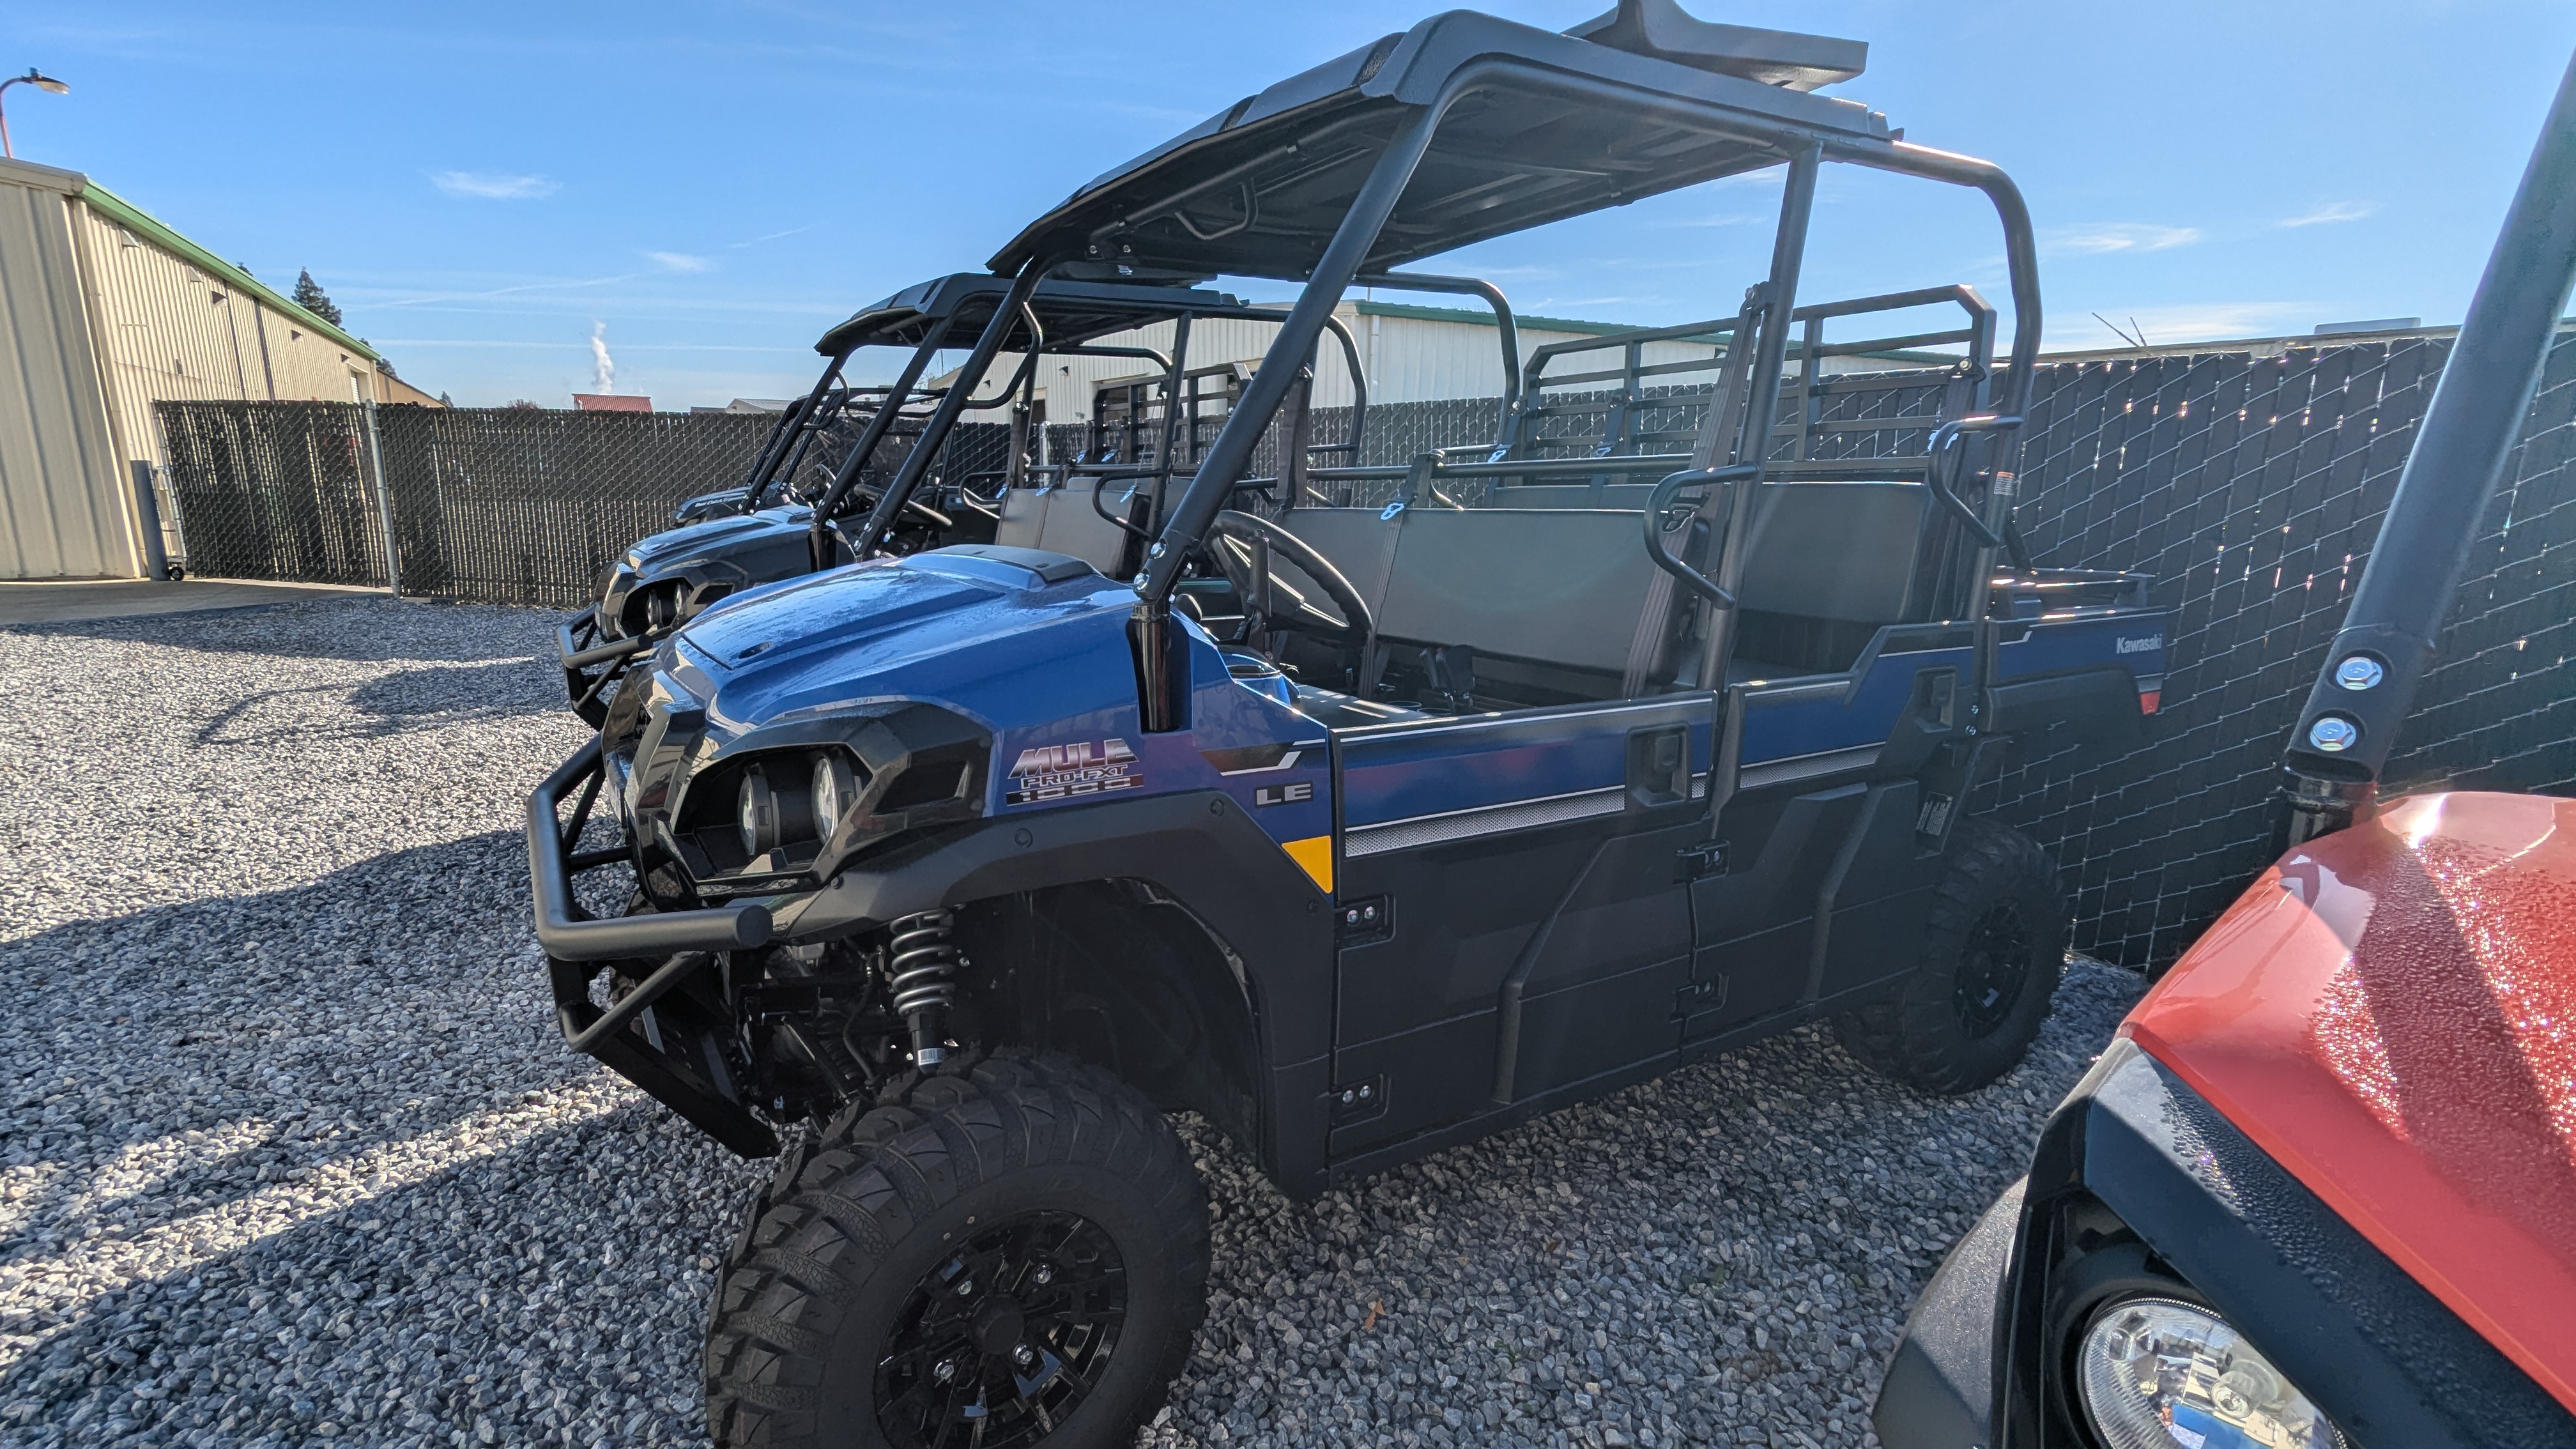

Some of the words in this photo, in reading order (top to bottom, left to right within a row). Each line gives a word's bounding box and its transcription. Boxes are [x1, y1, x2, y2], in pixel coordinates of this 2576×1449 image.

[2117, 633, 2162, 654] Kawasaki
[1008, 738, 1139, 779] MULE
[1021, 764, 1128, 789] PRO-FXT
[1020, 778, 1131, 801] 1000
[1257, 783, 1311, 805] LE
